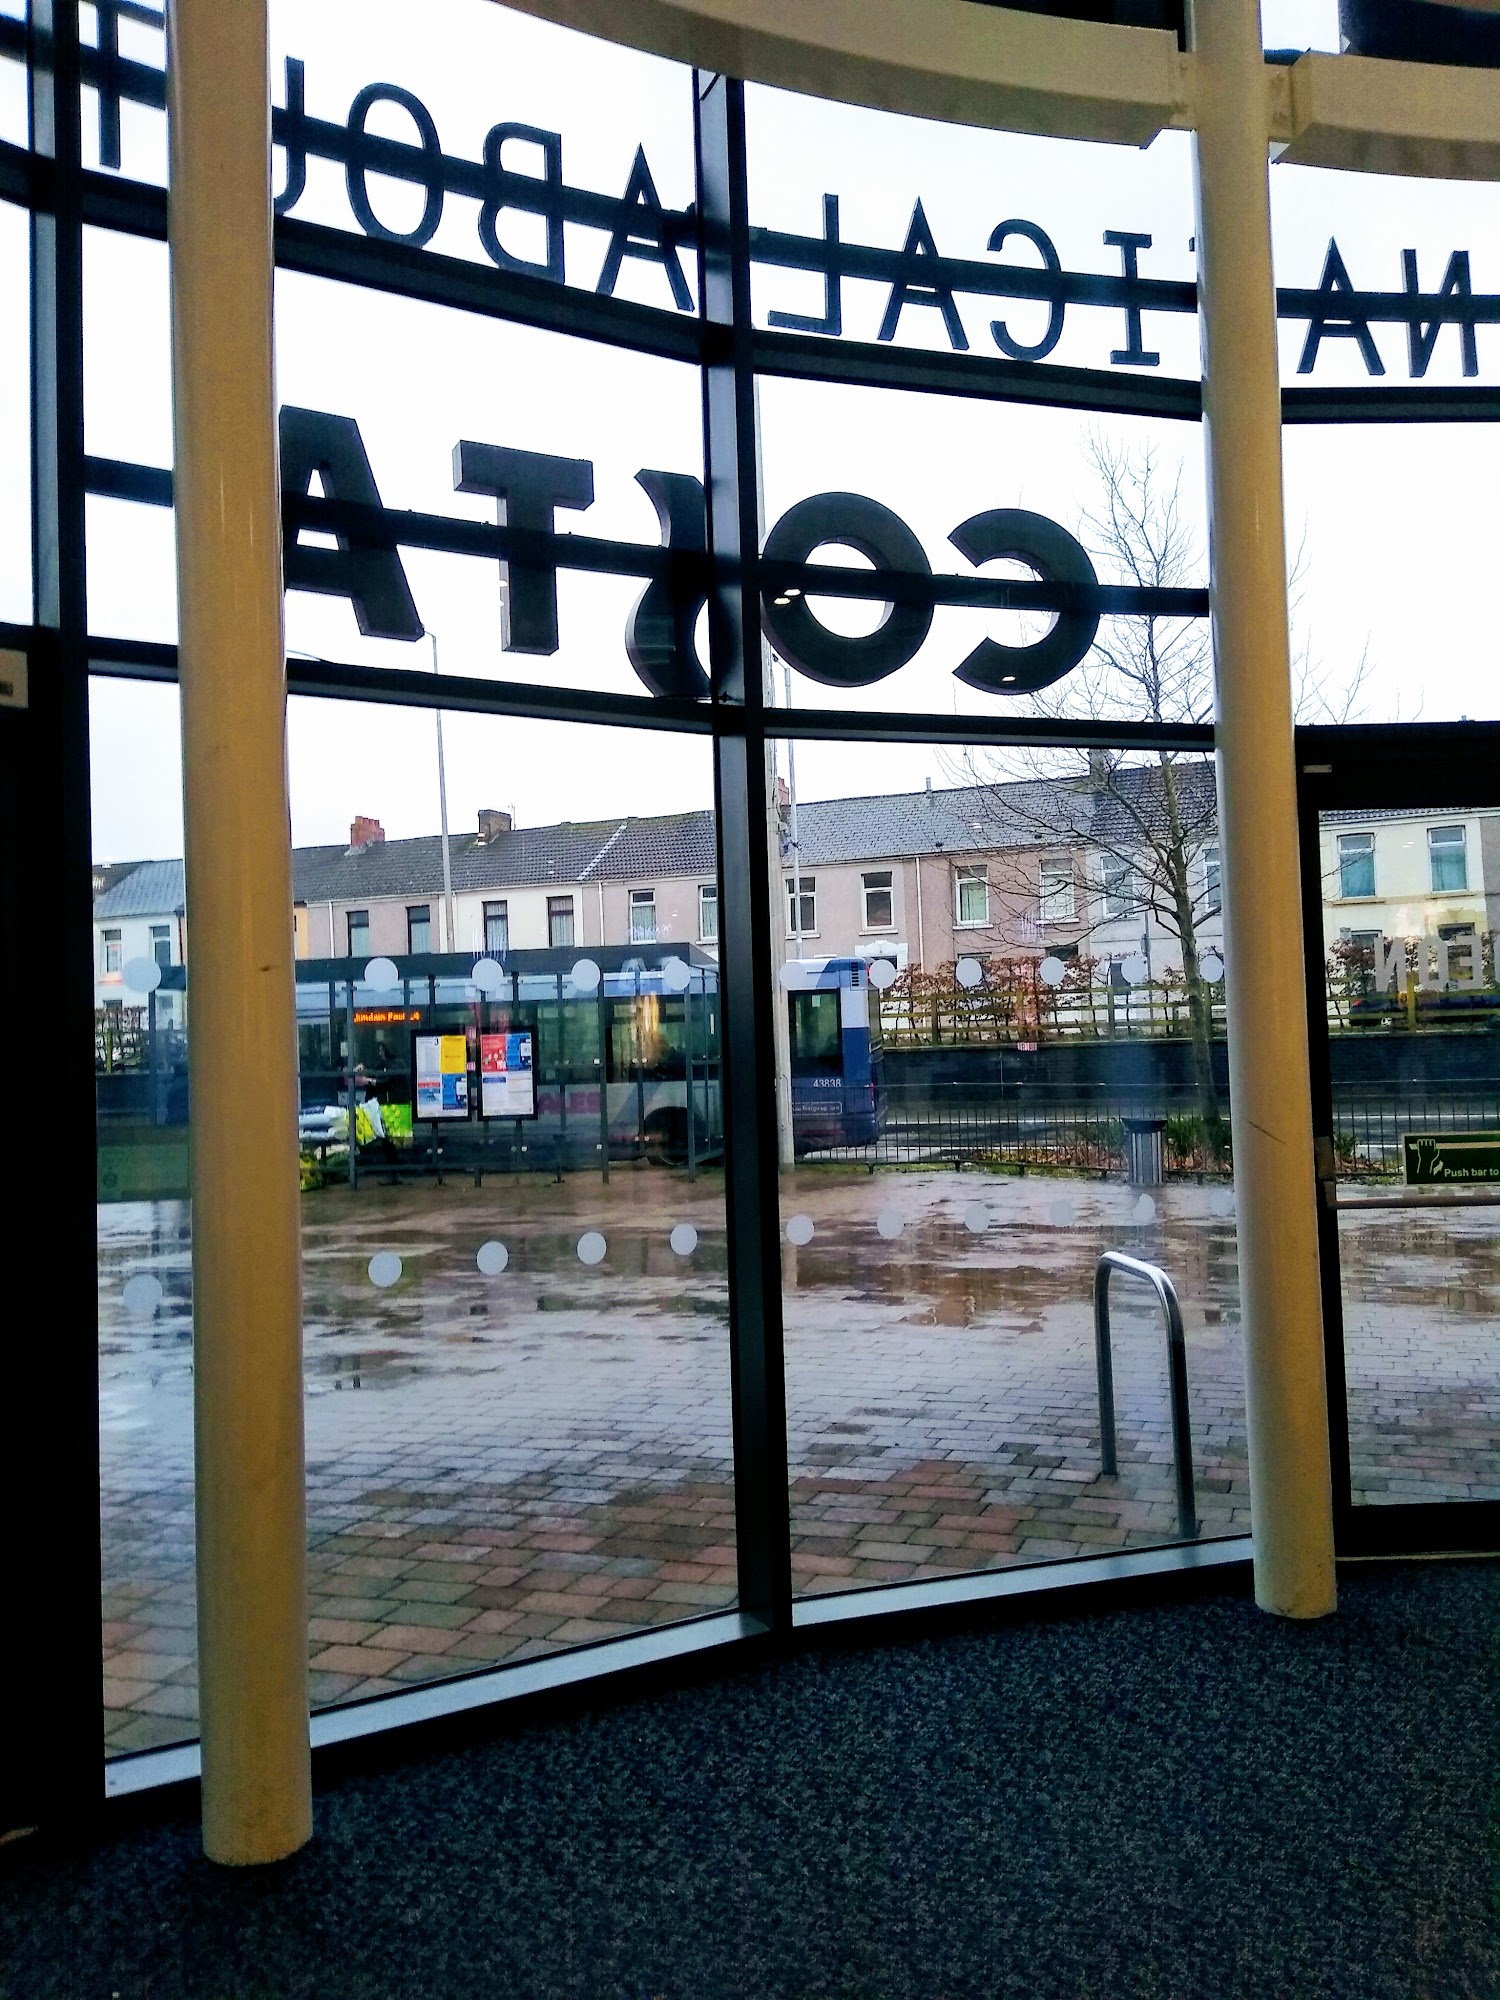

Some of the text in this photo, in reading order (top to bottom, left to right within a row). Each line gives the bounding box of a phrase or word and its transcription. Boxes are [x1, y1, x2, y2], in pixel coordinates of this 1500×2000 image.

[1444, 1168, 1499, 1177] Push bar to
